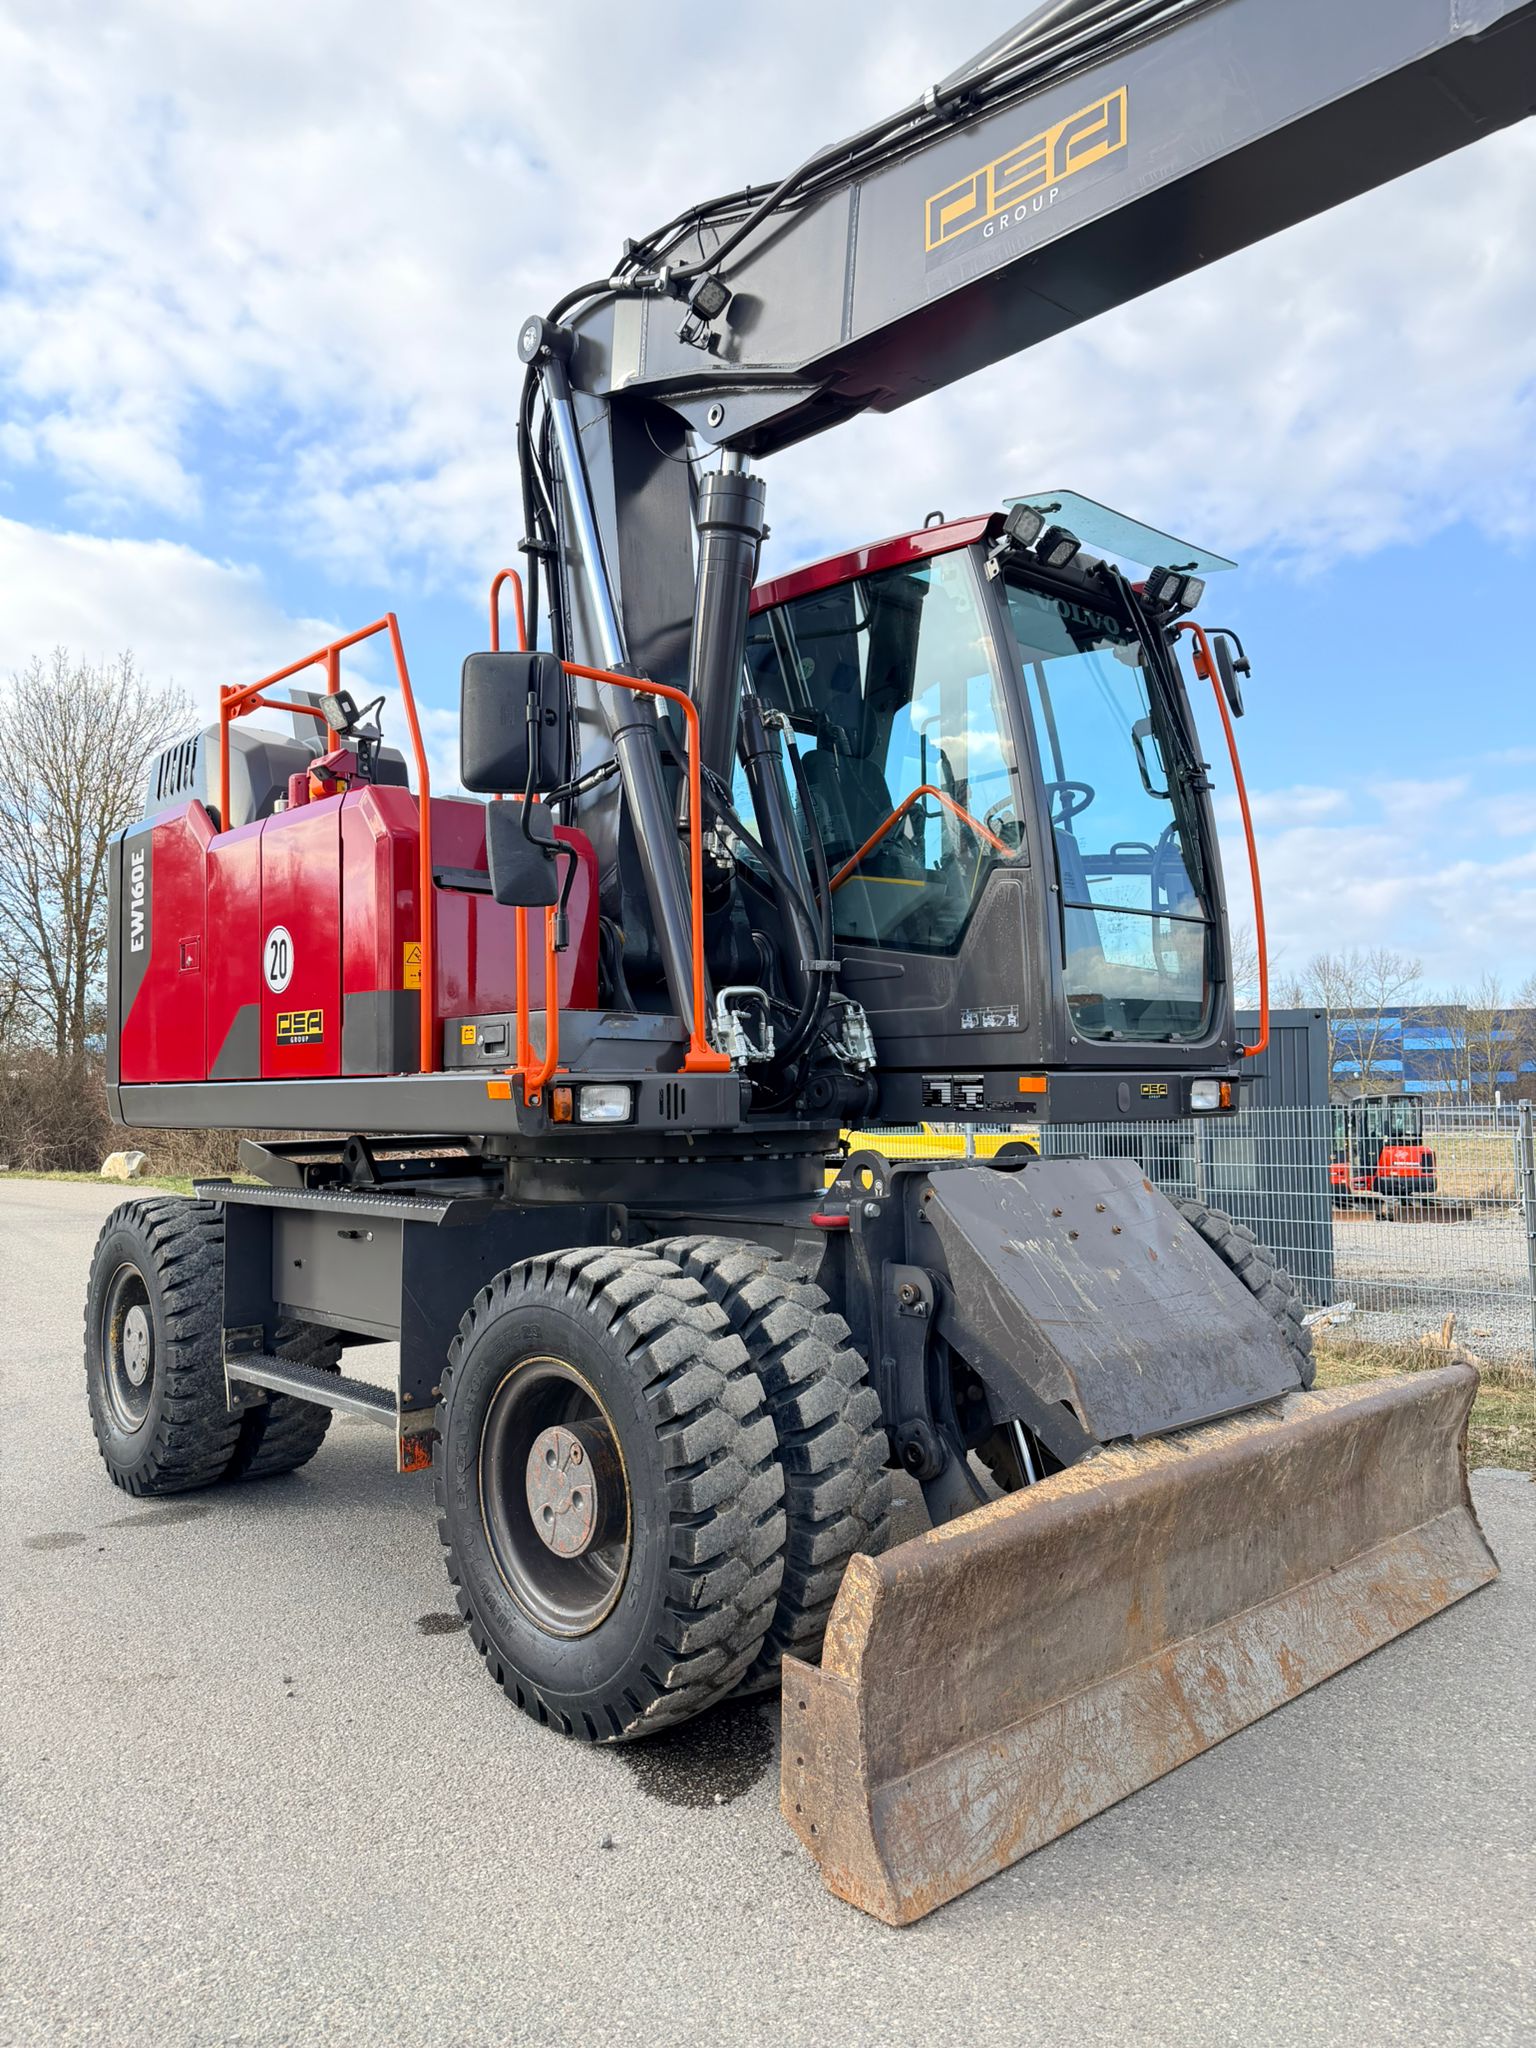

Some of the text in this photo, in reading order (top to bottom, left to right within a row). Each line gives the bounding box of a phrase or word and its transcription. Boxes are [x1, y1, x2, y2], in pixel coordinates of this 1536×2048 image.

[983, 187, 1059, 238] GROUP
[1031, 590, 1120, 636] VOLVO
[130, 848, 145, 953] EW160E
[270, 939, 287, 980] 20
